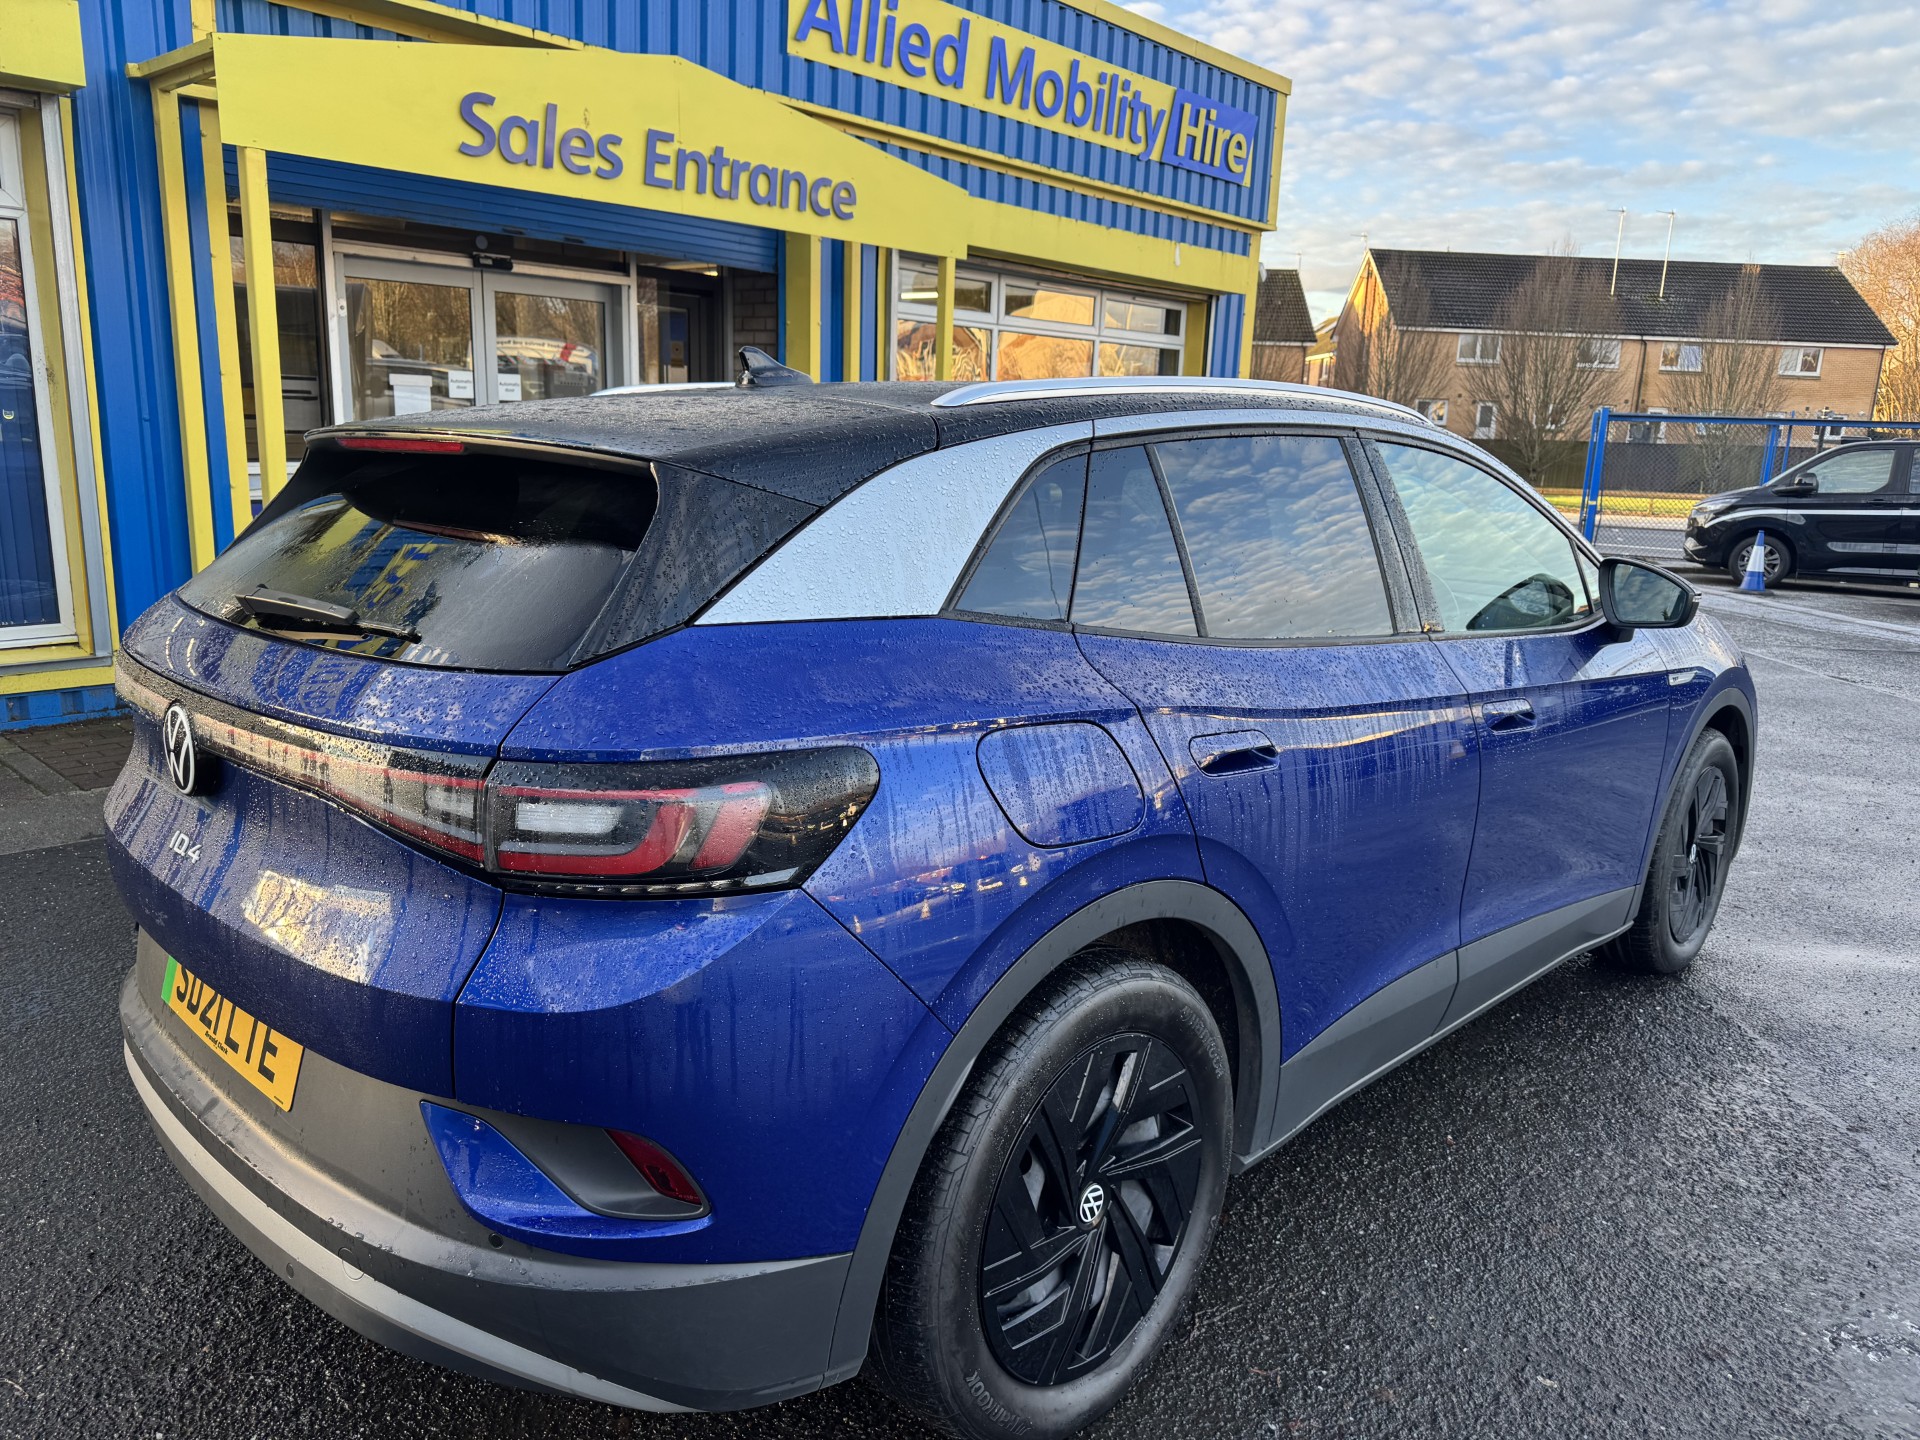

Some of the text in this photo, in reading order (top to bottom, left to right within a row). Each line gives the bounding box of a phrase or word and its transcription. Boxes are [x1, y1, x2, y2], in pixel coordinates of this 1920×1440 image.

[796, 0, 1251, 174] Allied Mobility Hire
[459, 92, 857, 220] Sales Entrance
[218, 1041, 228, 1055] Clark
